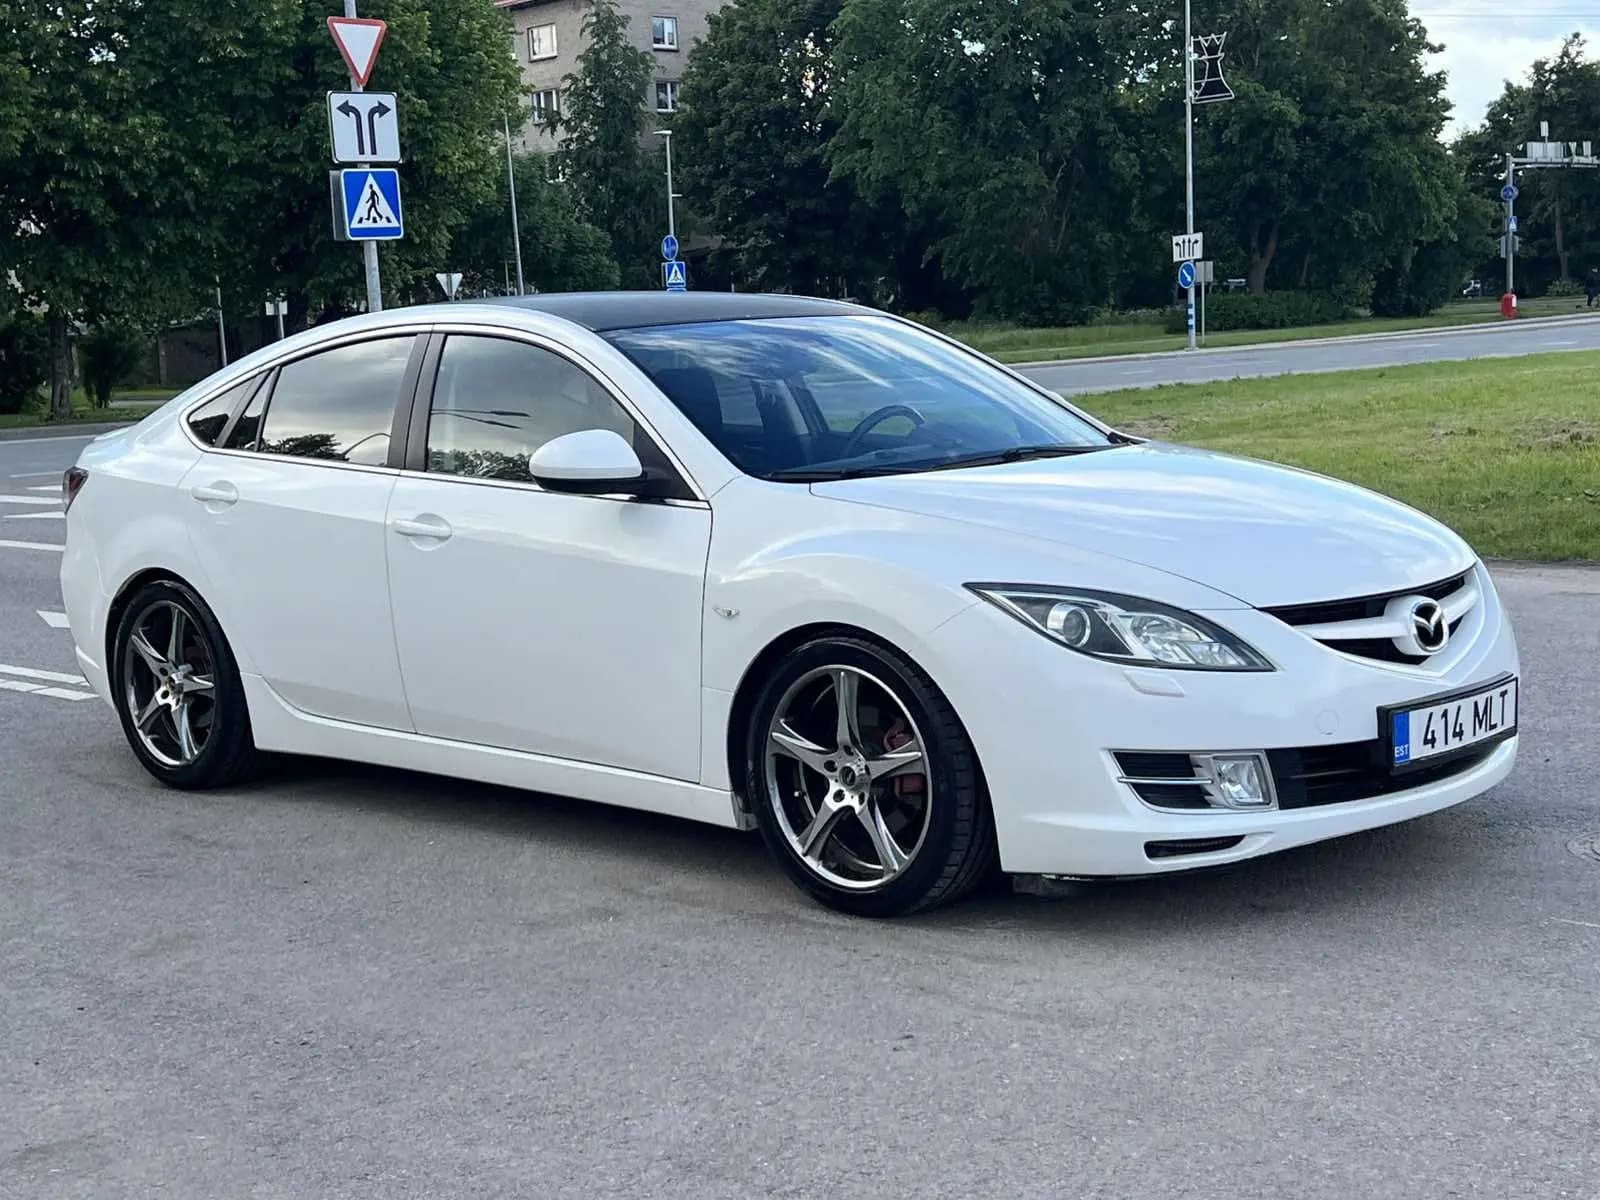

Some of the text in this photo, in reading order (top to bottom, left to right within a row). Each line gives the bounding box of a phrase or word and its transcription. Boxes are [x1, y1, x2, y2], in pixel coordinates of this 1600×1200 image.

[1423, 689, 1508, 749] 414 MLT
[1395, 744, 1408, 757] EST
